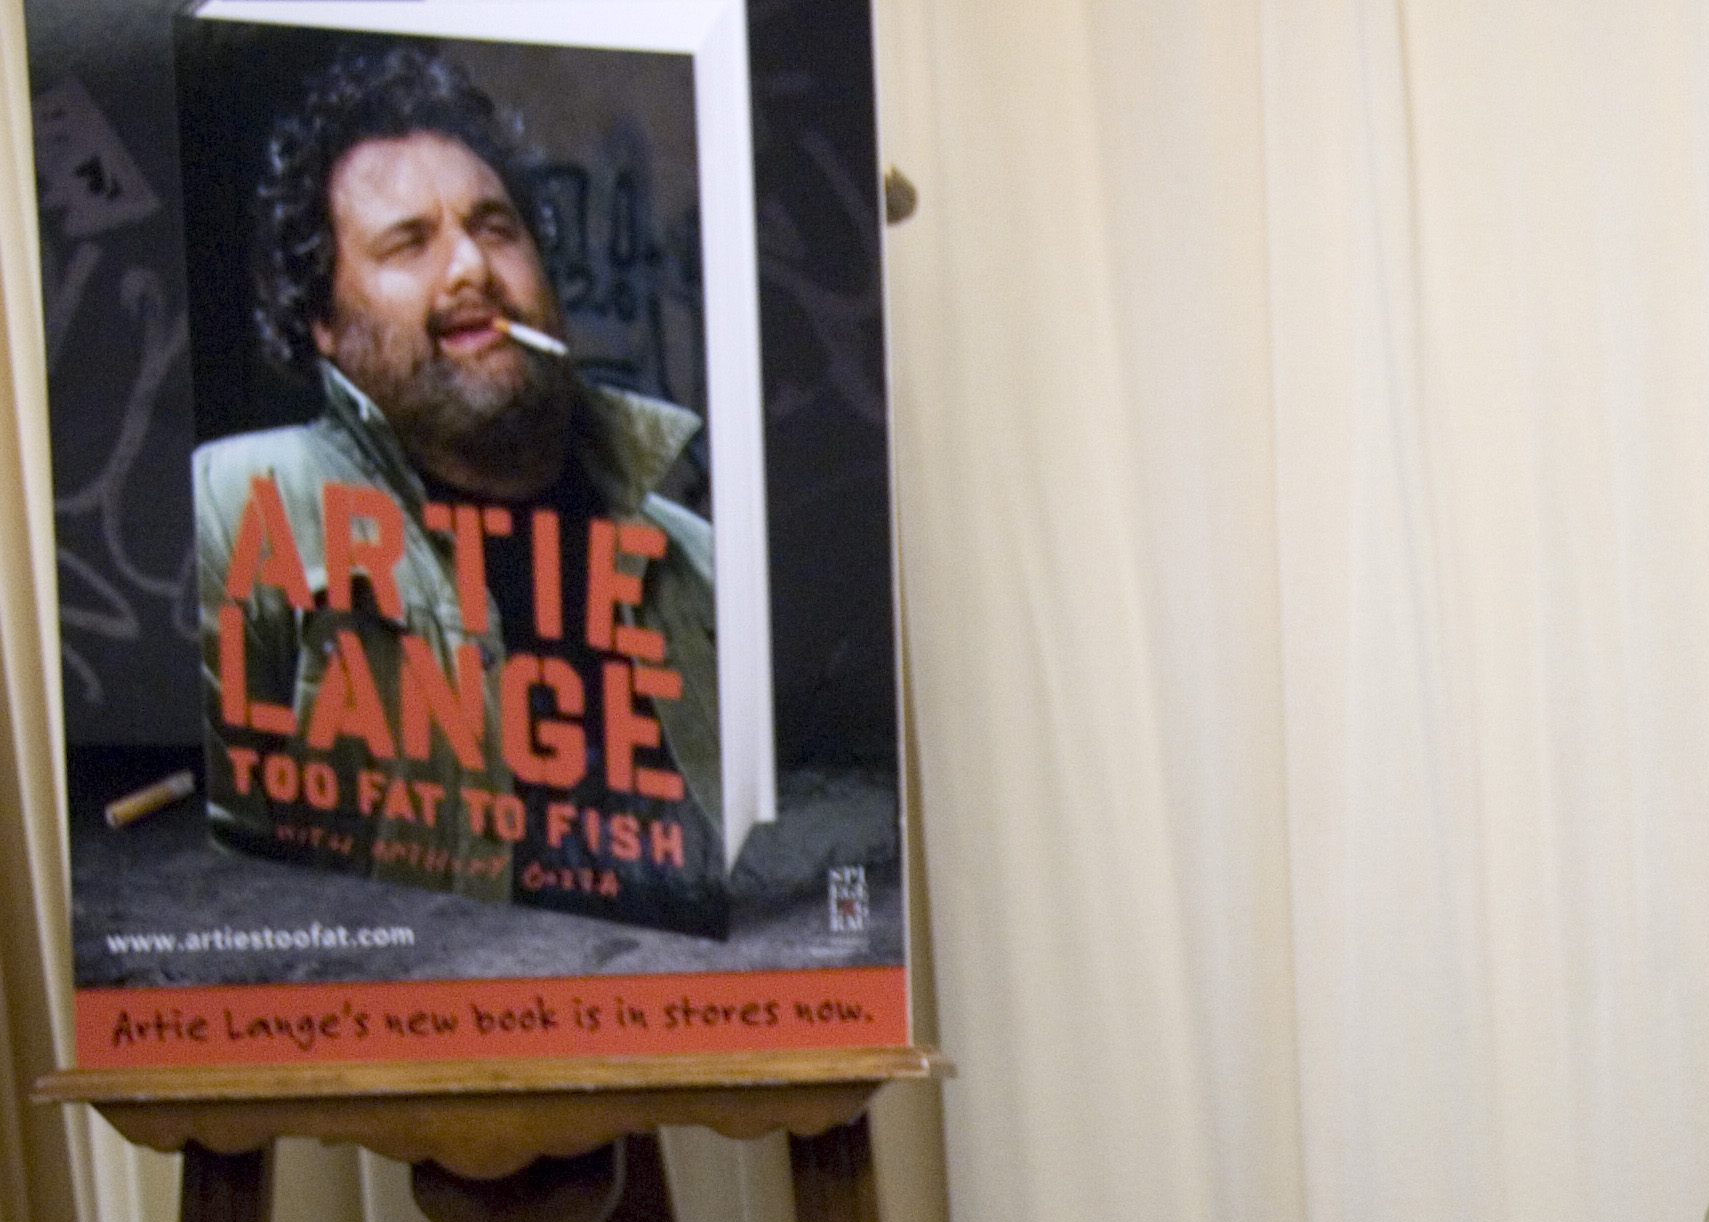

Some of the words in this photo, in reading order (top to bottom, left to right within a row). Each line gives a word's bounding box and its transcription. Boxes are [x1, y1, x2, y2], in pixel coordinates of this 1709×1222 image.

[224, 472, 667, 662] ARTIE
[219, 602, 685, 801] LANGE
[227, 746, 339, 810] TOO
[356, 768, 446, 828] FAT
[459, 786, 527, 842] TO
[546, 802, 686, 868] FISH
[106, 920, 415, 954] www.artiestoofat.com
[112, 1009, 208, 1048] Artie
[224, 1000, 371, 1050] Lange's
[384, 1009, 459, 1037] new
[471, 996, 557, 1035] book
[573, 997, 601, 1032] is
[615, 997, 648, 1029] in
[663, 996, 779, 1029] stores
[794, 1000, 874, 1025] now.
